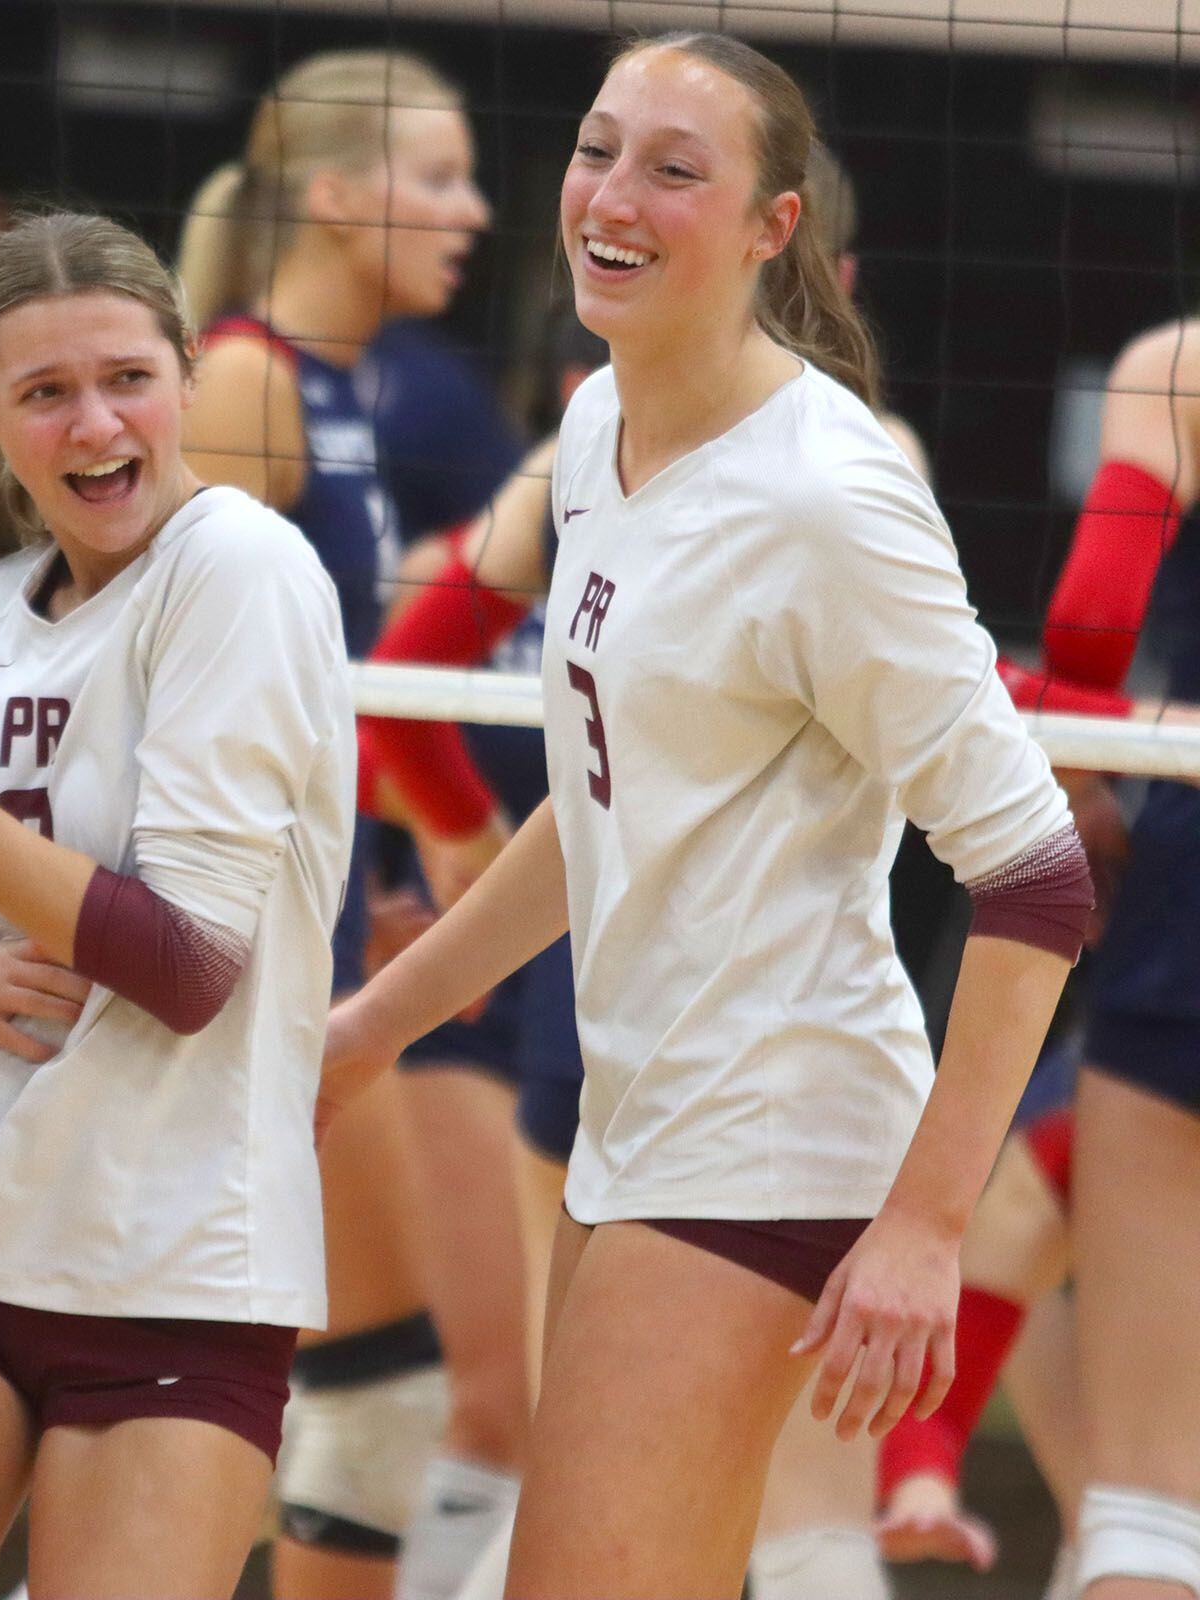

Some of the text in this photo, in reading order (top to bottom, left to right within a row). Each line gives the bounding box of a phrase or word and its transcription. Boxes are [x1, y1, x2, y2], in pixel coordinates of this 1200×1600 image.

[569, 571, 616, 653] PR
[0, 696, 71, 768] PR
[566, 660, 612, 811] 3
